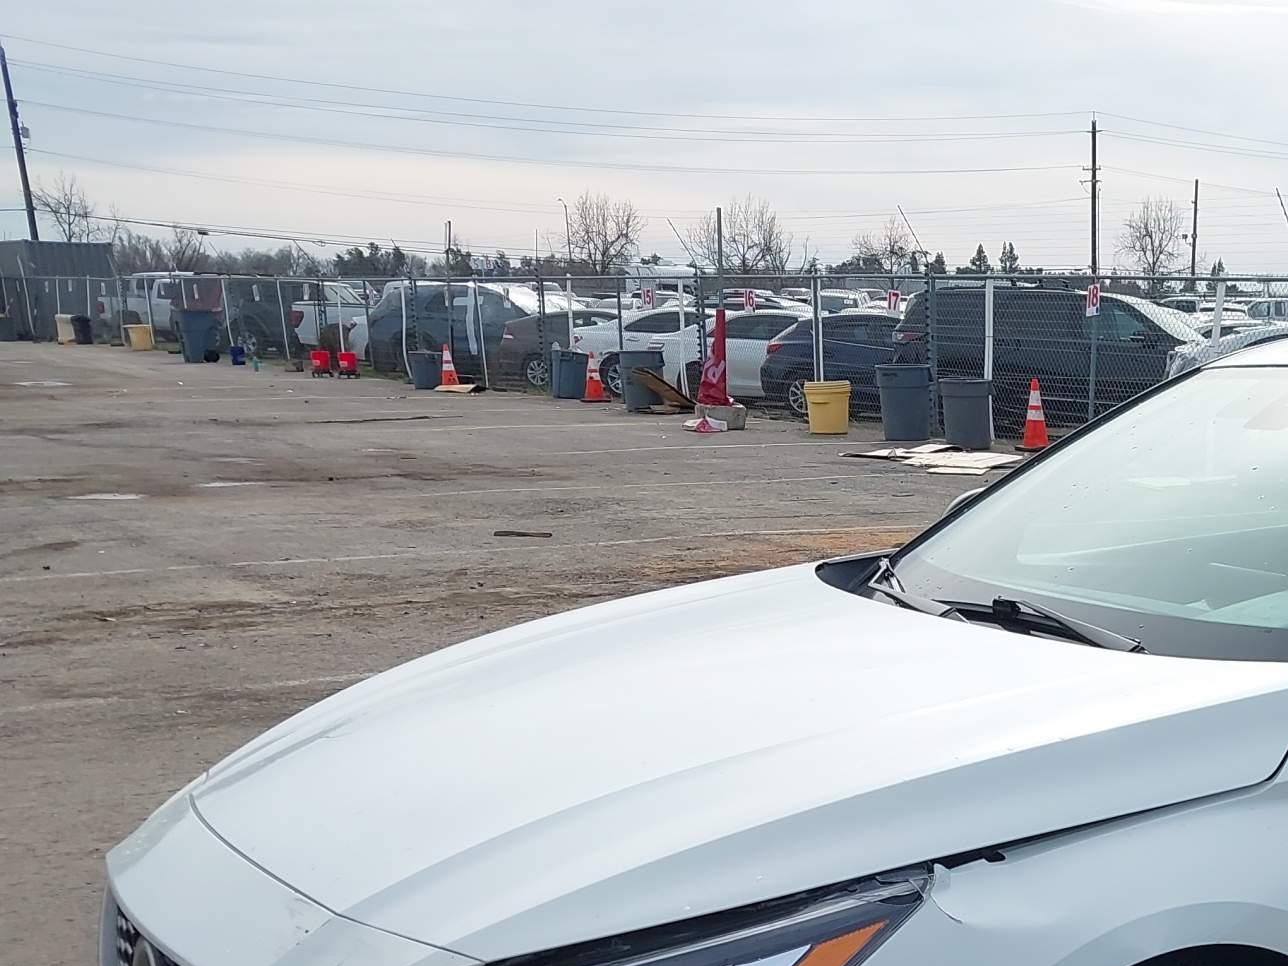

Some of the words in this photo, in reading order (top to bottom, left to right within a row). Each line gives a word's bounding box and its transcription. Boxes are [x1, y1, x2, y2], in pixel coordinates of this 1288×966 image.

[643, 290, 652, 305] 15
[745, 290, 754, 308] 16
[888, 292, 900, 311] 17
[1088, 286, 1099, 308] 18
